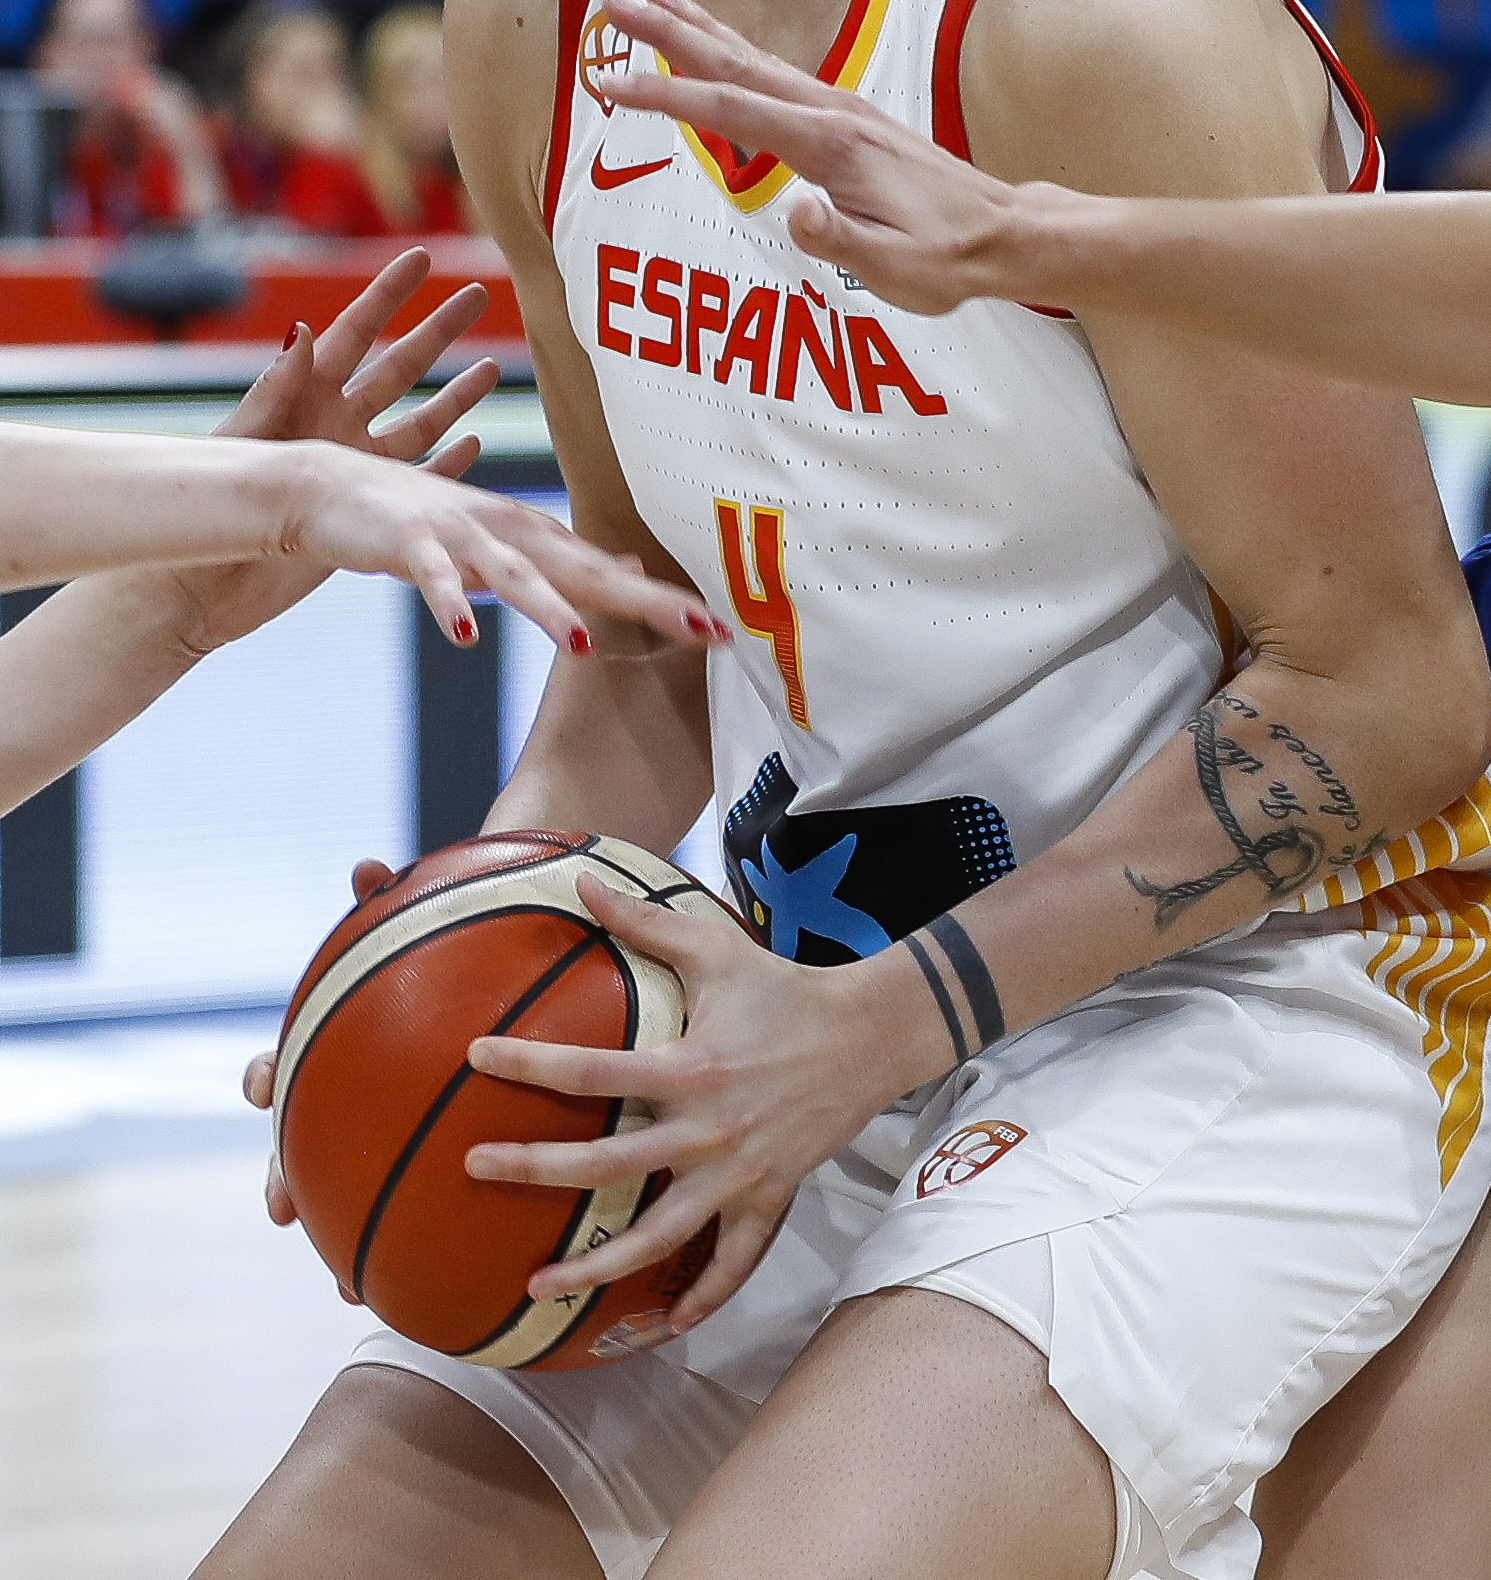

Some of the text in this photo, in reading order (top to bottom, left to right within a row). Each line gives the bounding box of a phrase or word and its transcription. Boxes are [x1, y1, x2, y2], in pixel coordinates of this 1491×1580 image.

[597, 242, 949, 417] ESPAÑA
[713, 497, 813, 732] 4
[994, 1125, 1019, 1143] FEB
